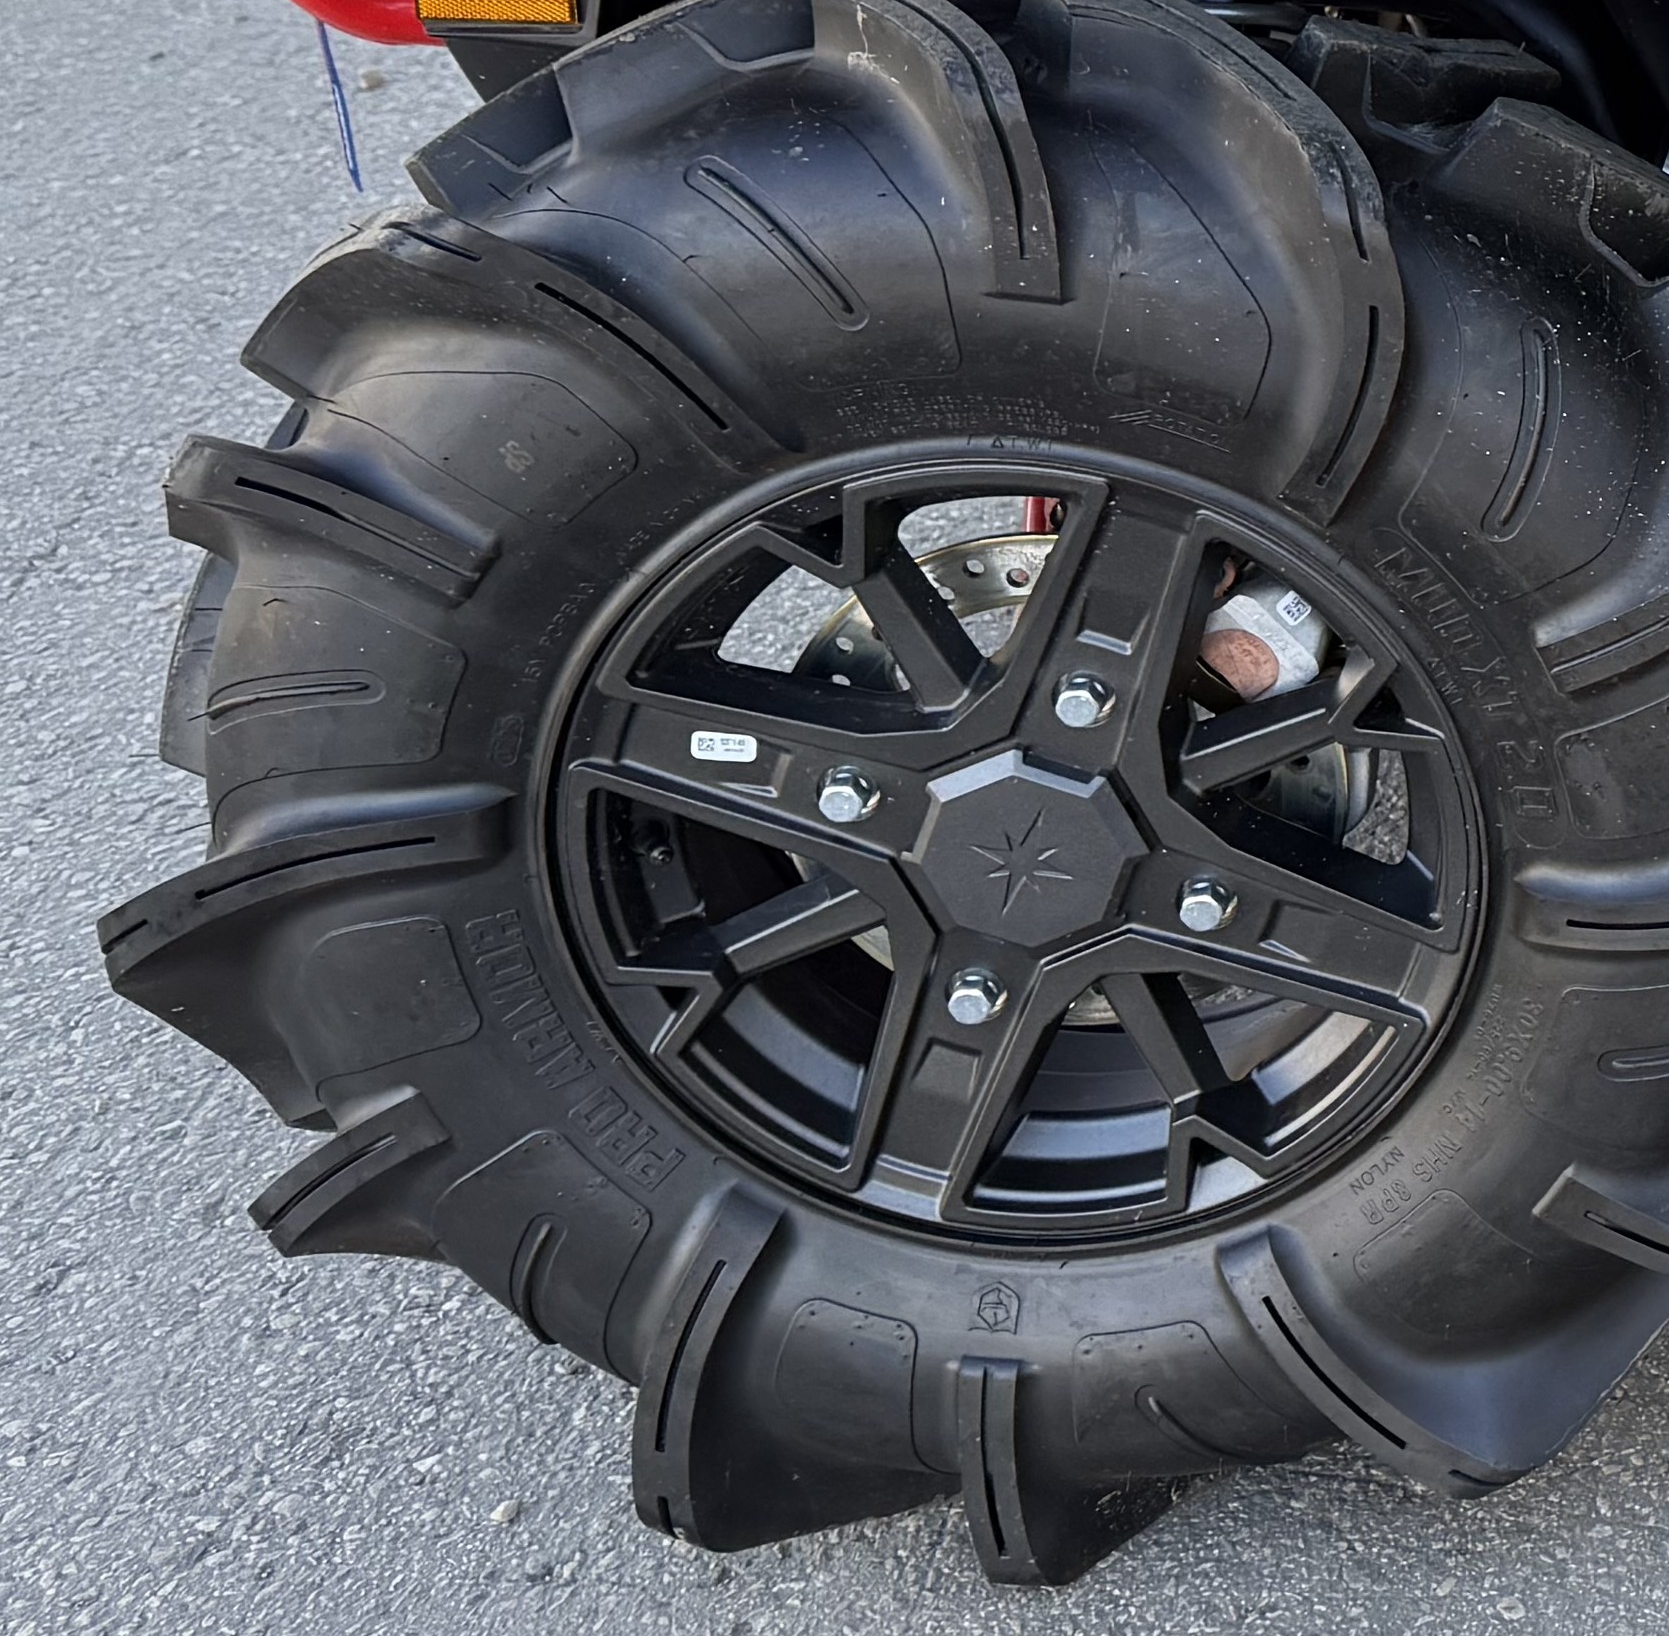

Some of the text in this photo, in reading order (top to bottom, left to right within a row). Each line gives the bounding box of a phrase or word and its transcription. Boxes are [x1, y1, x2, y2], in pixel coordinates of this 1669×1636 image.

[465, 908, 687, 1193] PRO ARMOR
[1349, 1145, 1405, 1196] NYLON
[1411, 1132, 1463, 1183] NHS
[1359, 1178, 1412, 1225] 8PR
